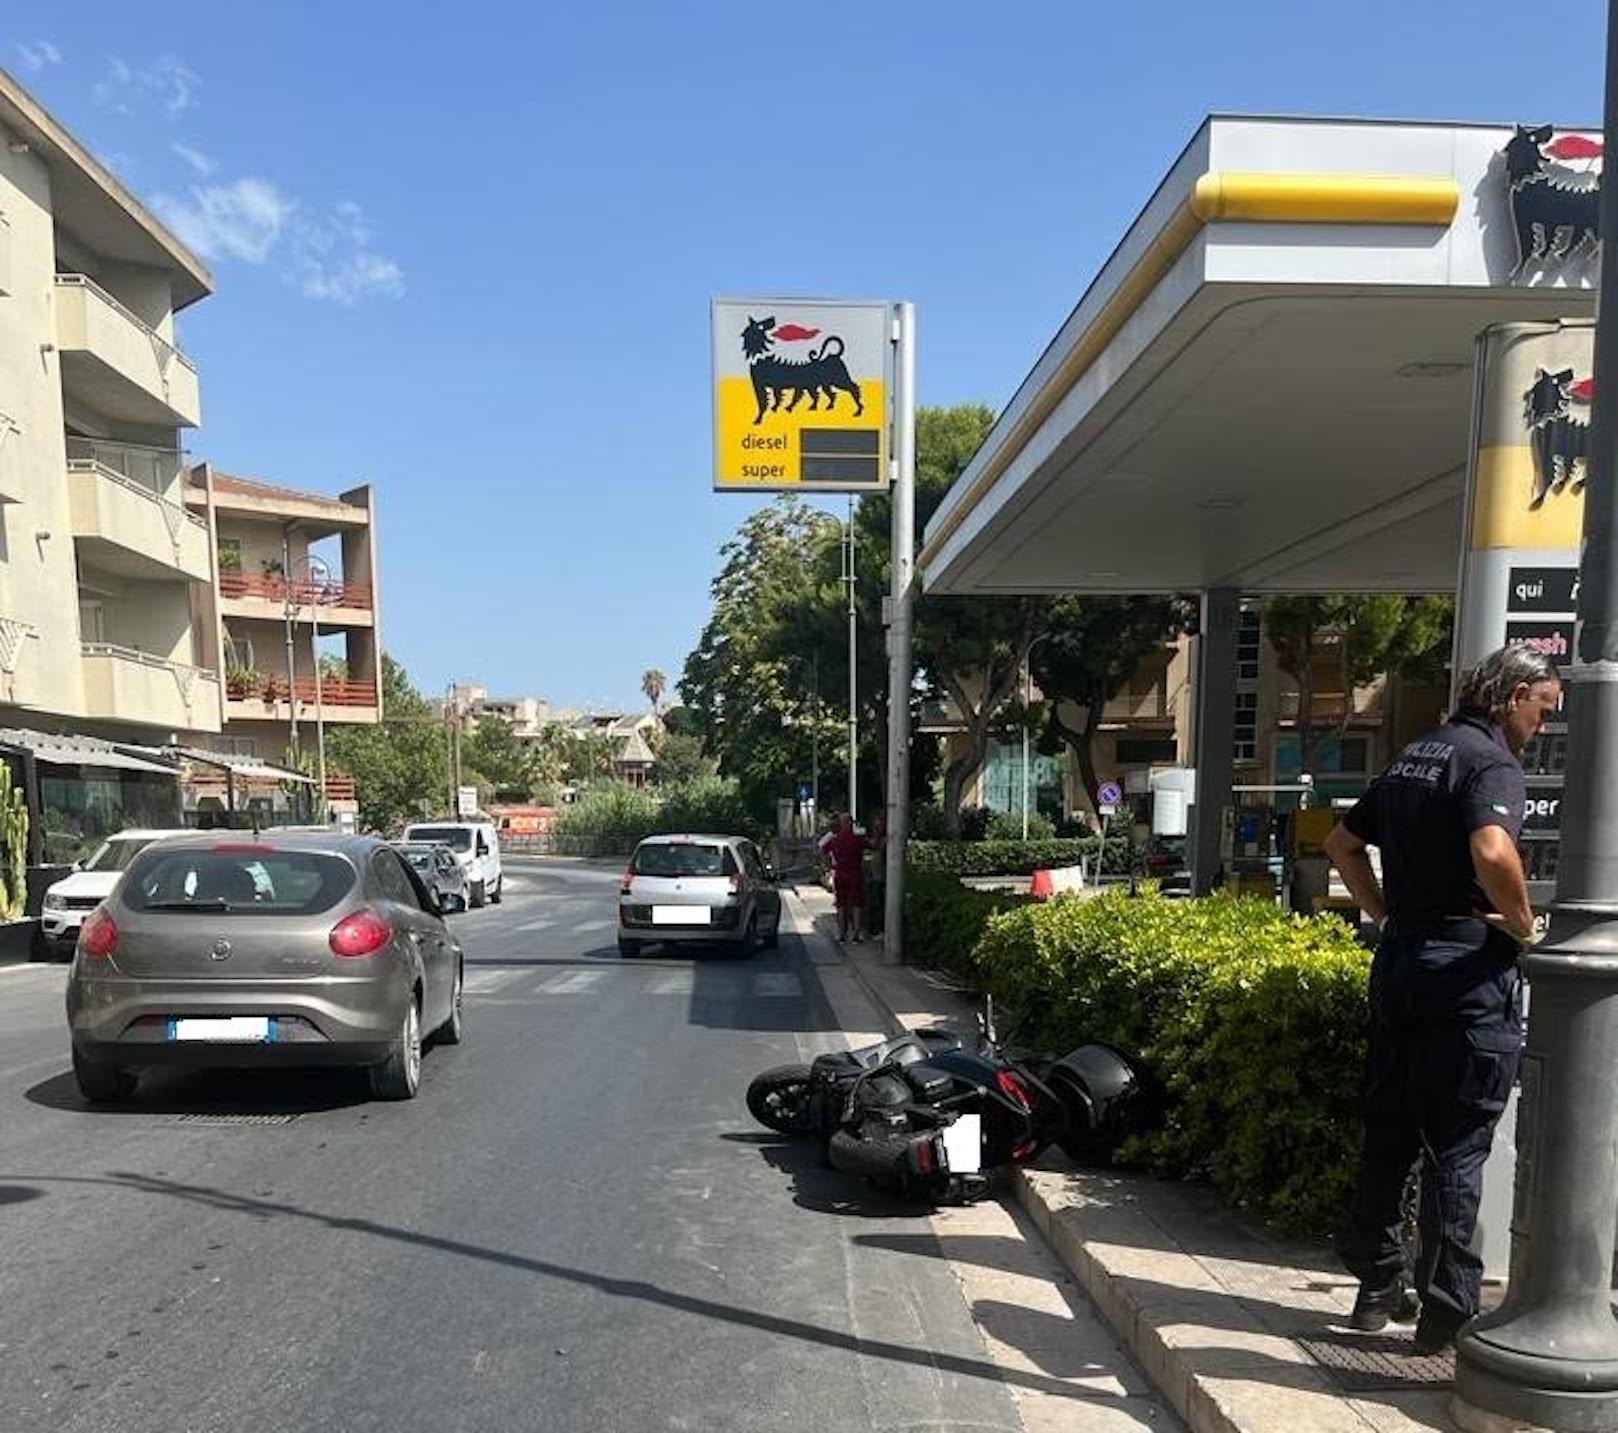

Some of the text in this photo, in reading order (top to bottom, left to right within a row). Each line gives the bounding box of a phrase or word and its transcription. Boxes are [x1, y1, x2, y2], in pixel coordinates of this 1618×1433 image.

[741, 434, 787, 449] diesel
[741, 465, 785, 480] super
[1515, 579, 1544, 601] qui
[1387, 762, 1443, 781] OCALE
